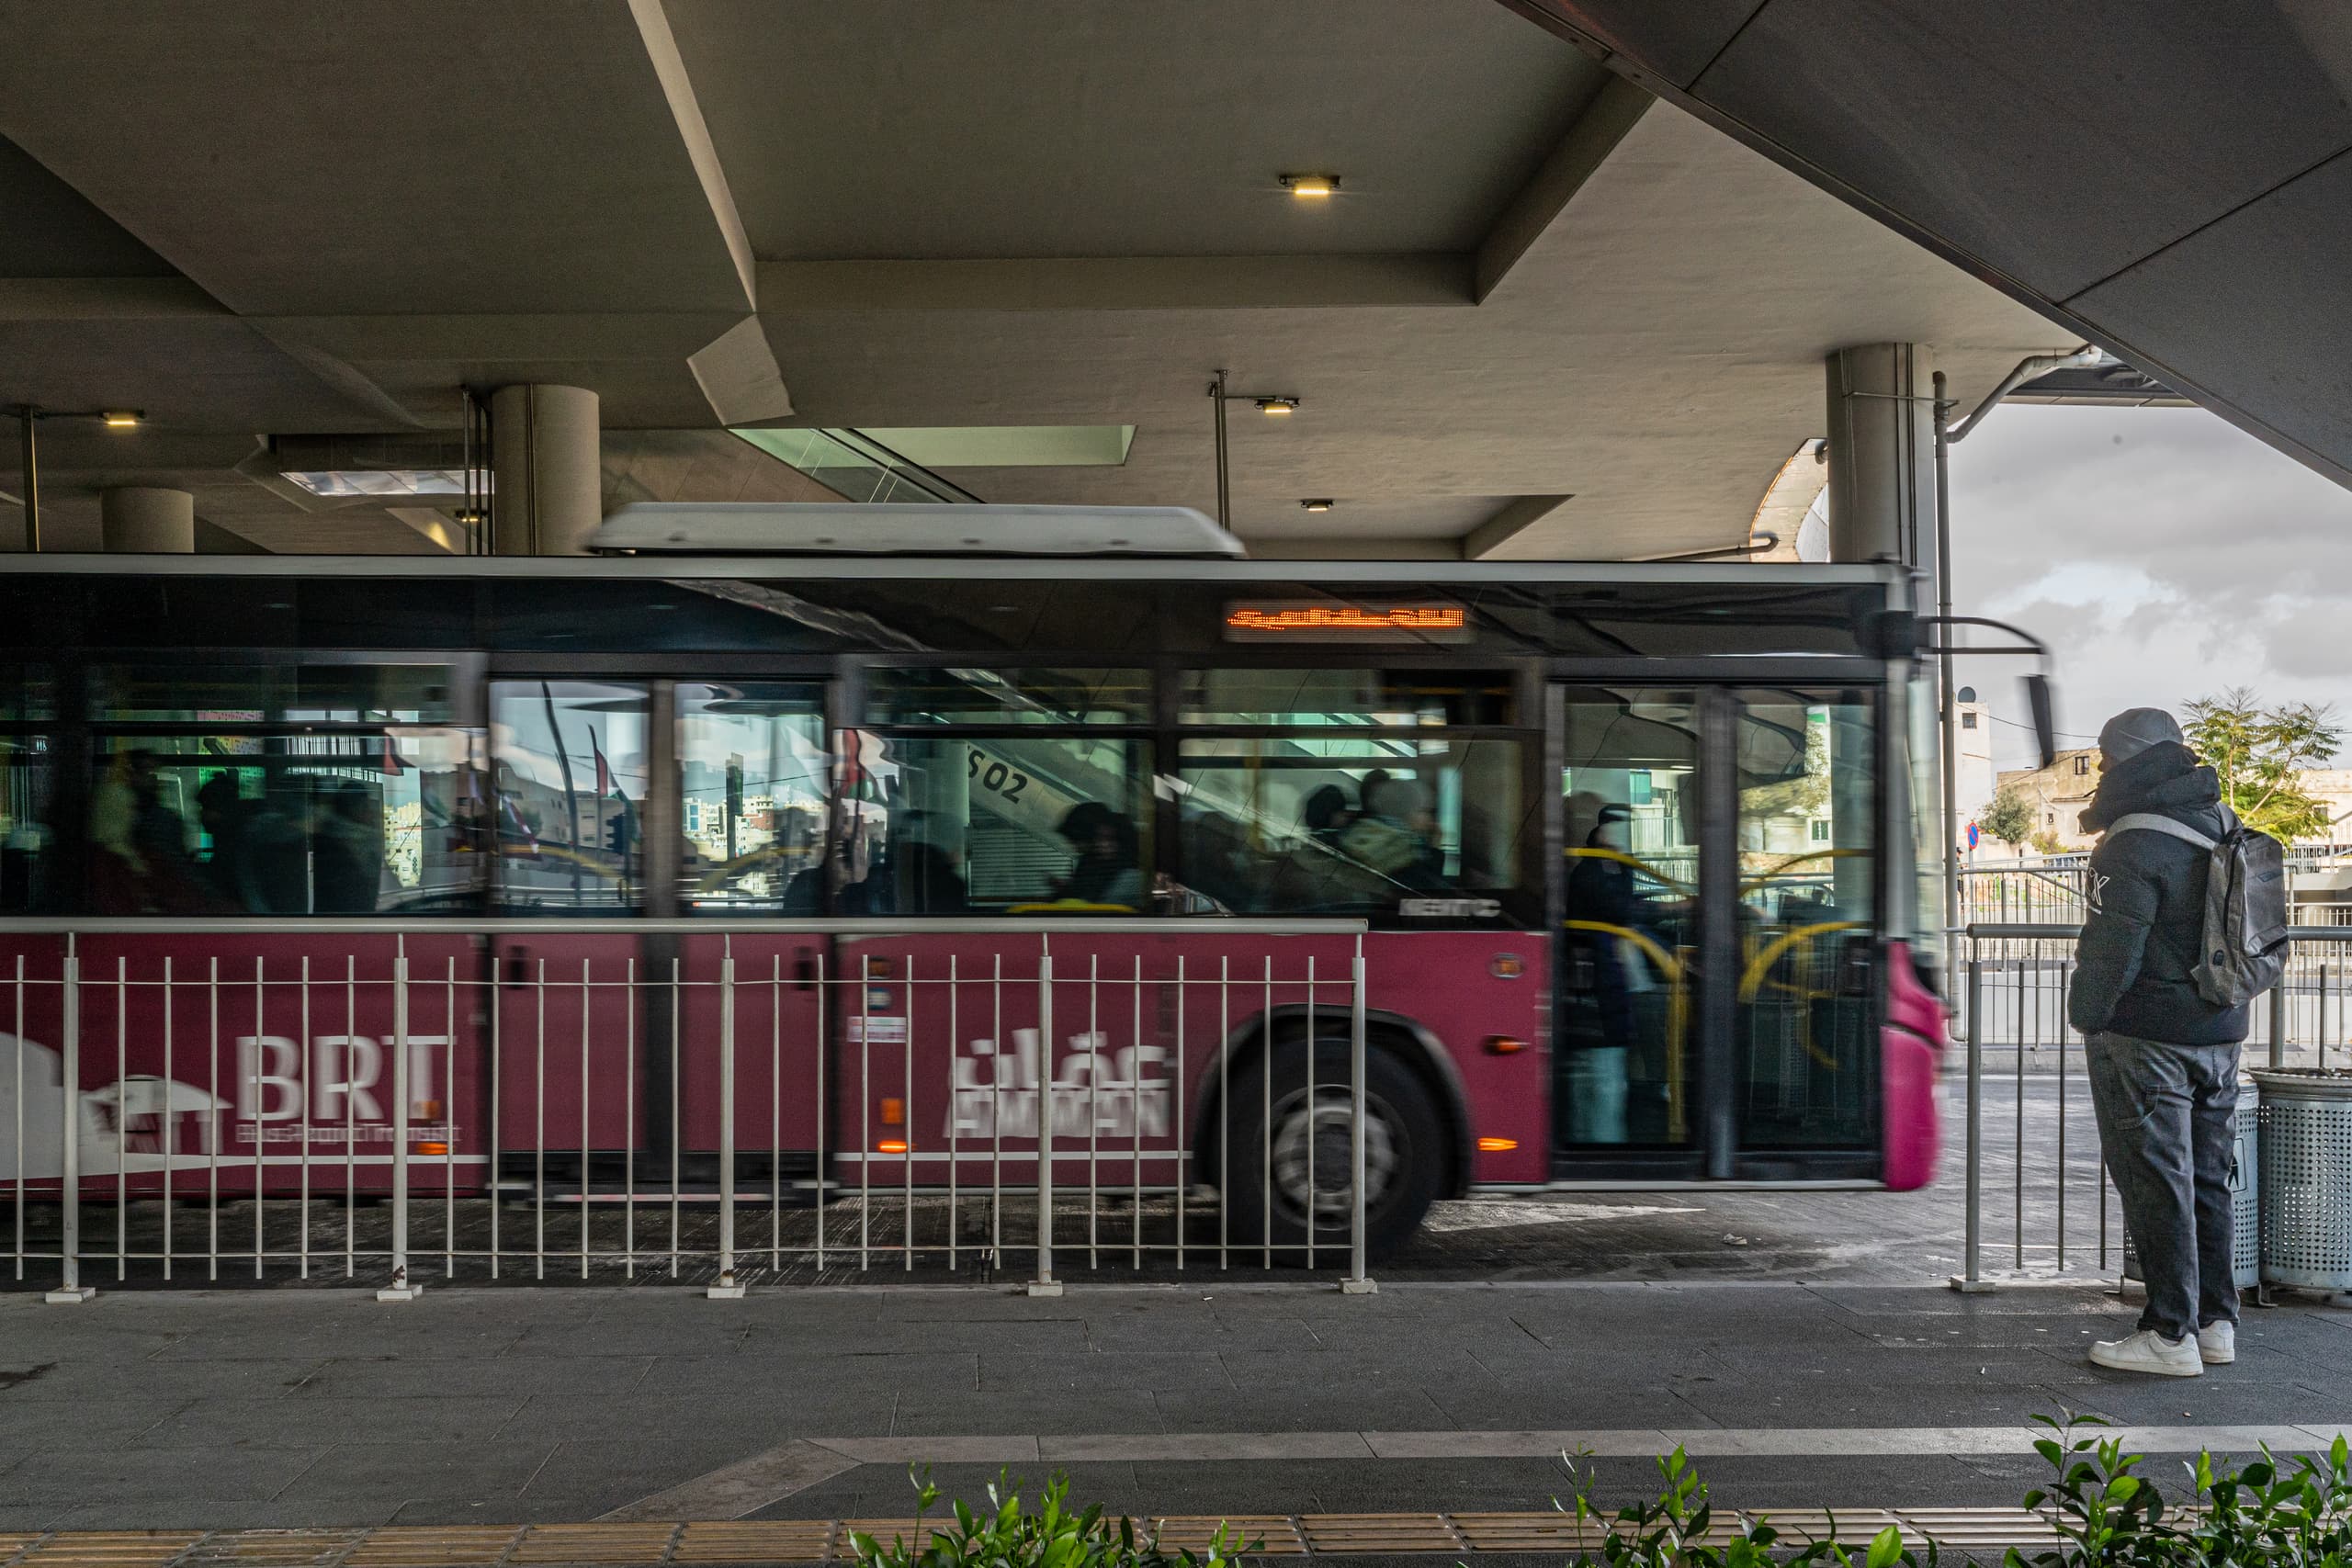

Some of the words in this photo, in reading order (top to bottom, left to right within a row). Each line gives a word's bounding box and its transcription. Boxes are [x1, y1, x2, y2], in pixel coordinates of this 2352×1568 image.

[968, 745, 986, 779] S
[983, 762, 1028, 805] 02
[235, 1035, 458, 1122] BRT
